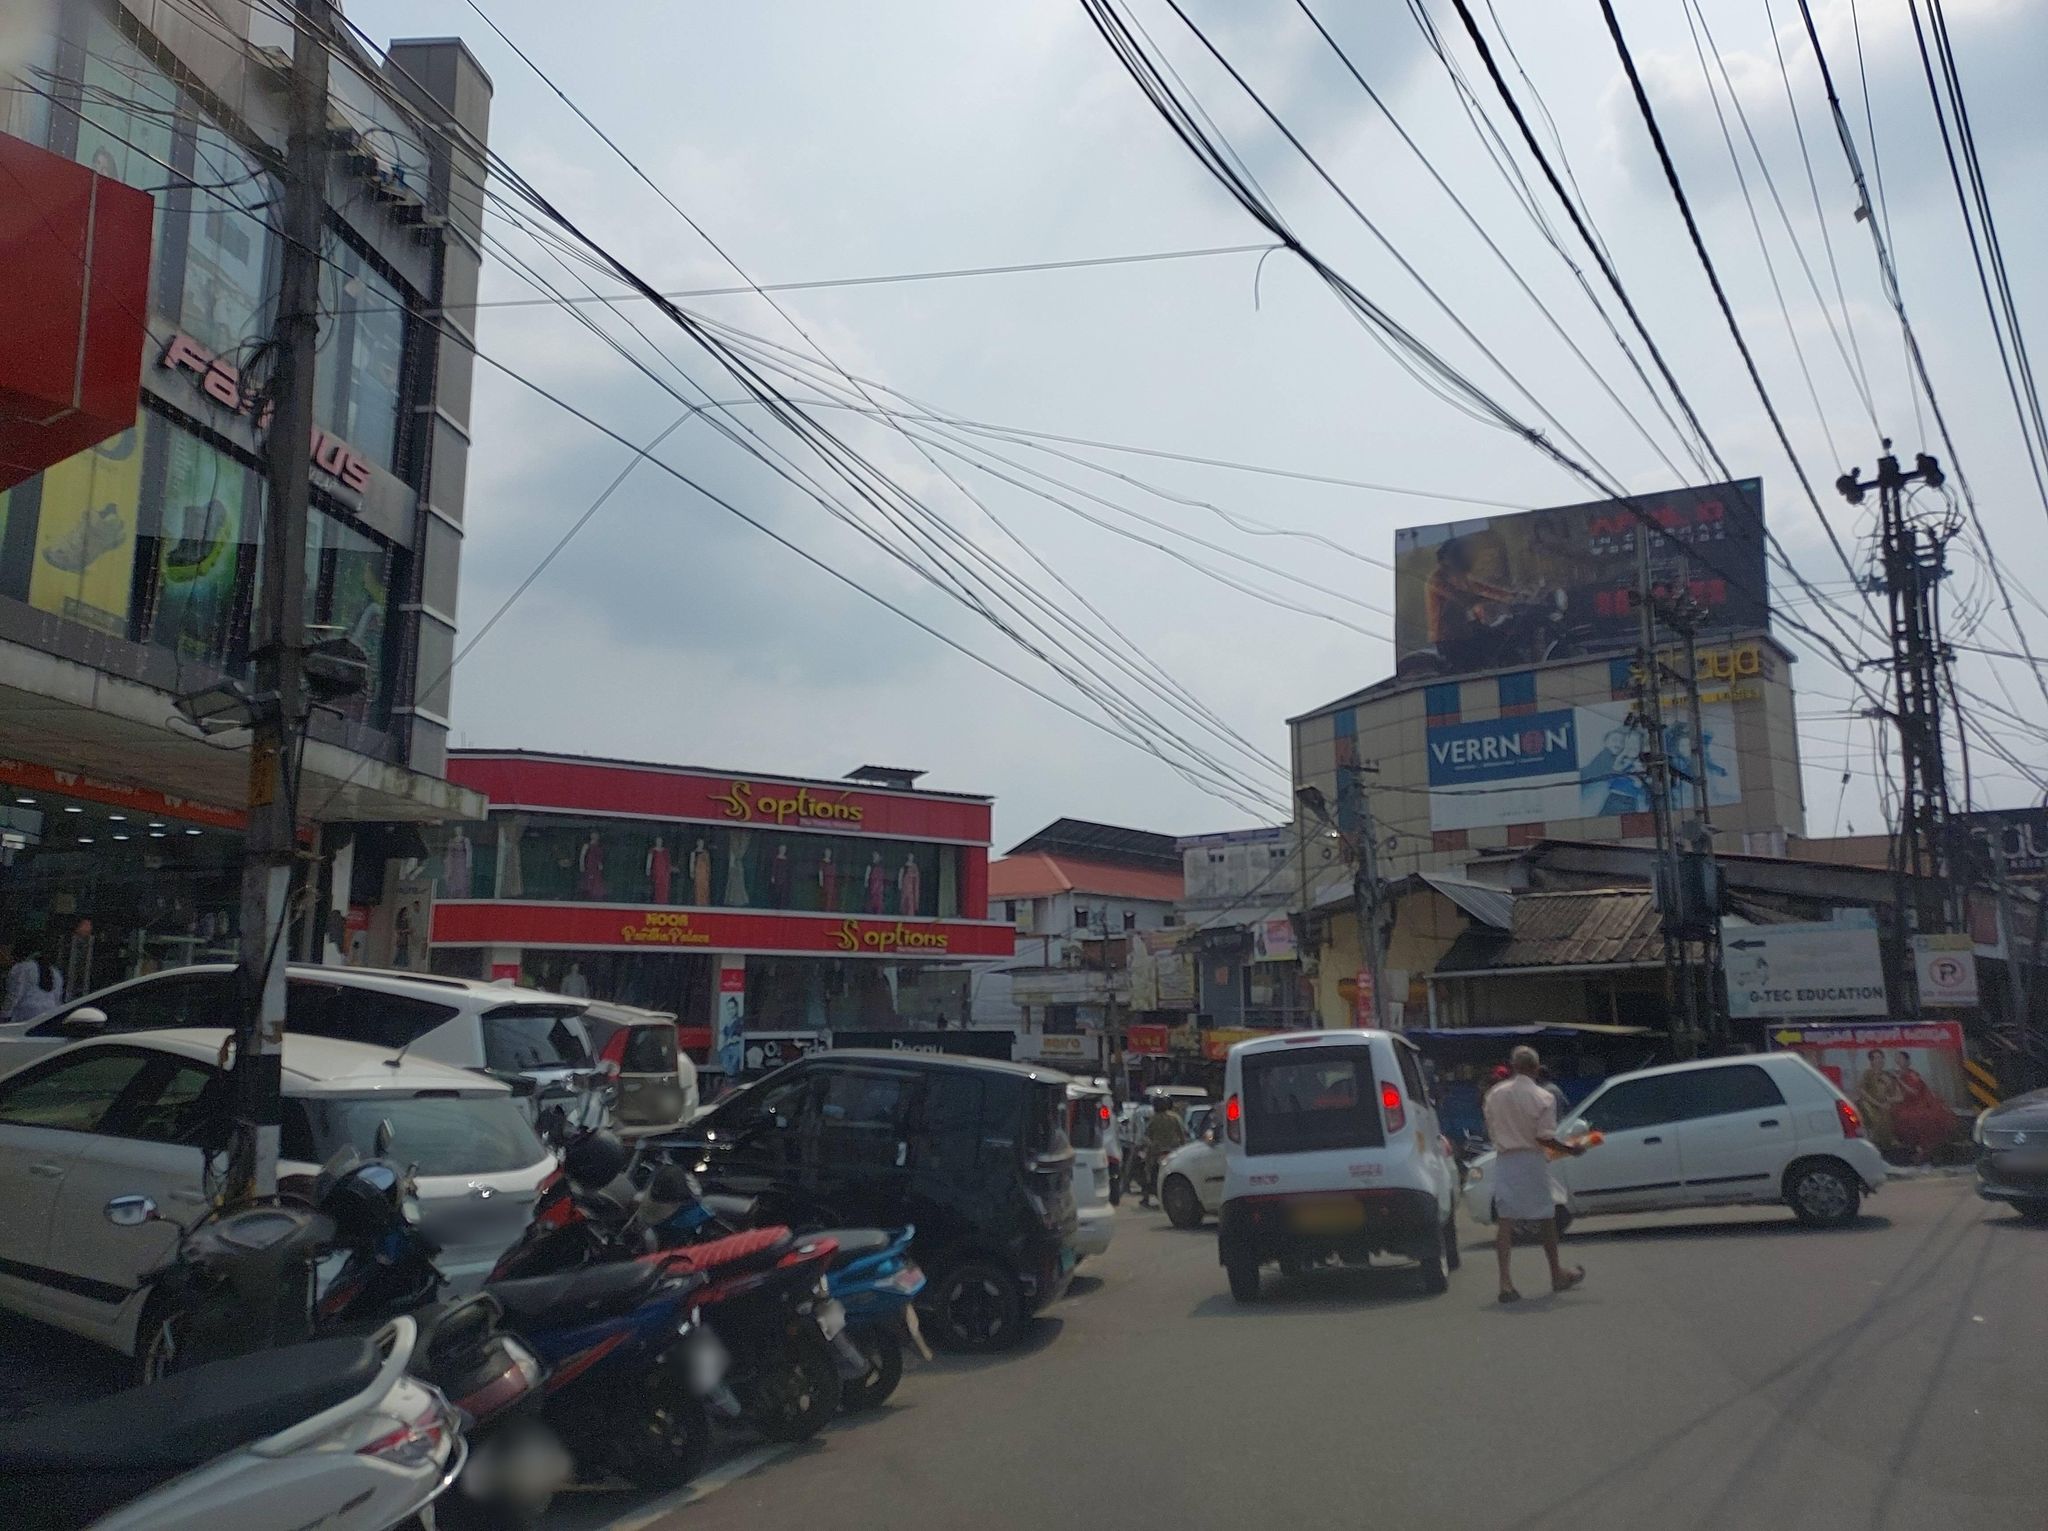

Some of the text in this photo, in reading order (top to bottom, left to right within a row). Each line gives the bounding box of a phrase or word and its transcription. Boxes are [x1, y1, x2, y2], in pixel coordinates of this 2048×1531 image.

[757, 787, 864, 825] options
[863, 921, 949, 952] options
[1797, 986, 1883, 1001] EDUCATION
